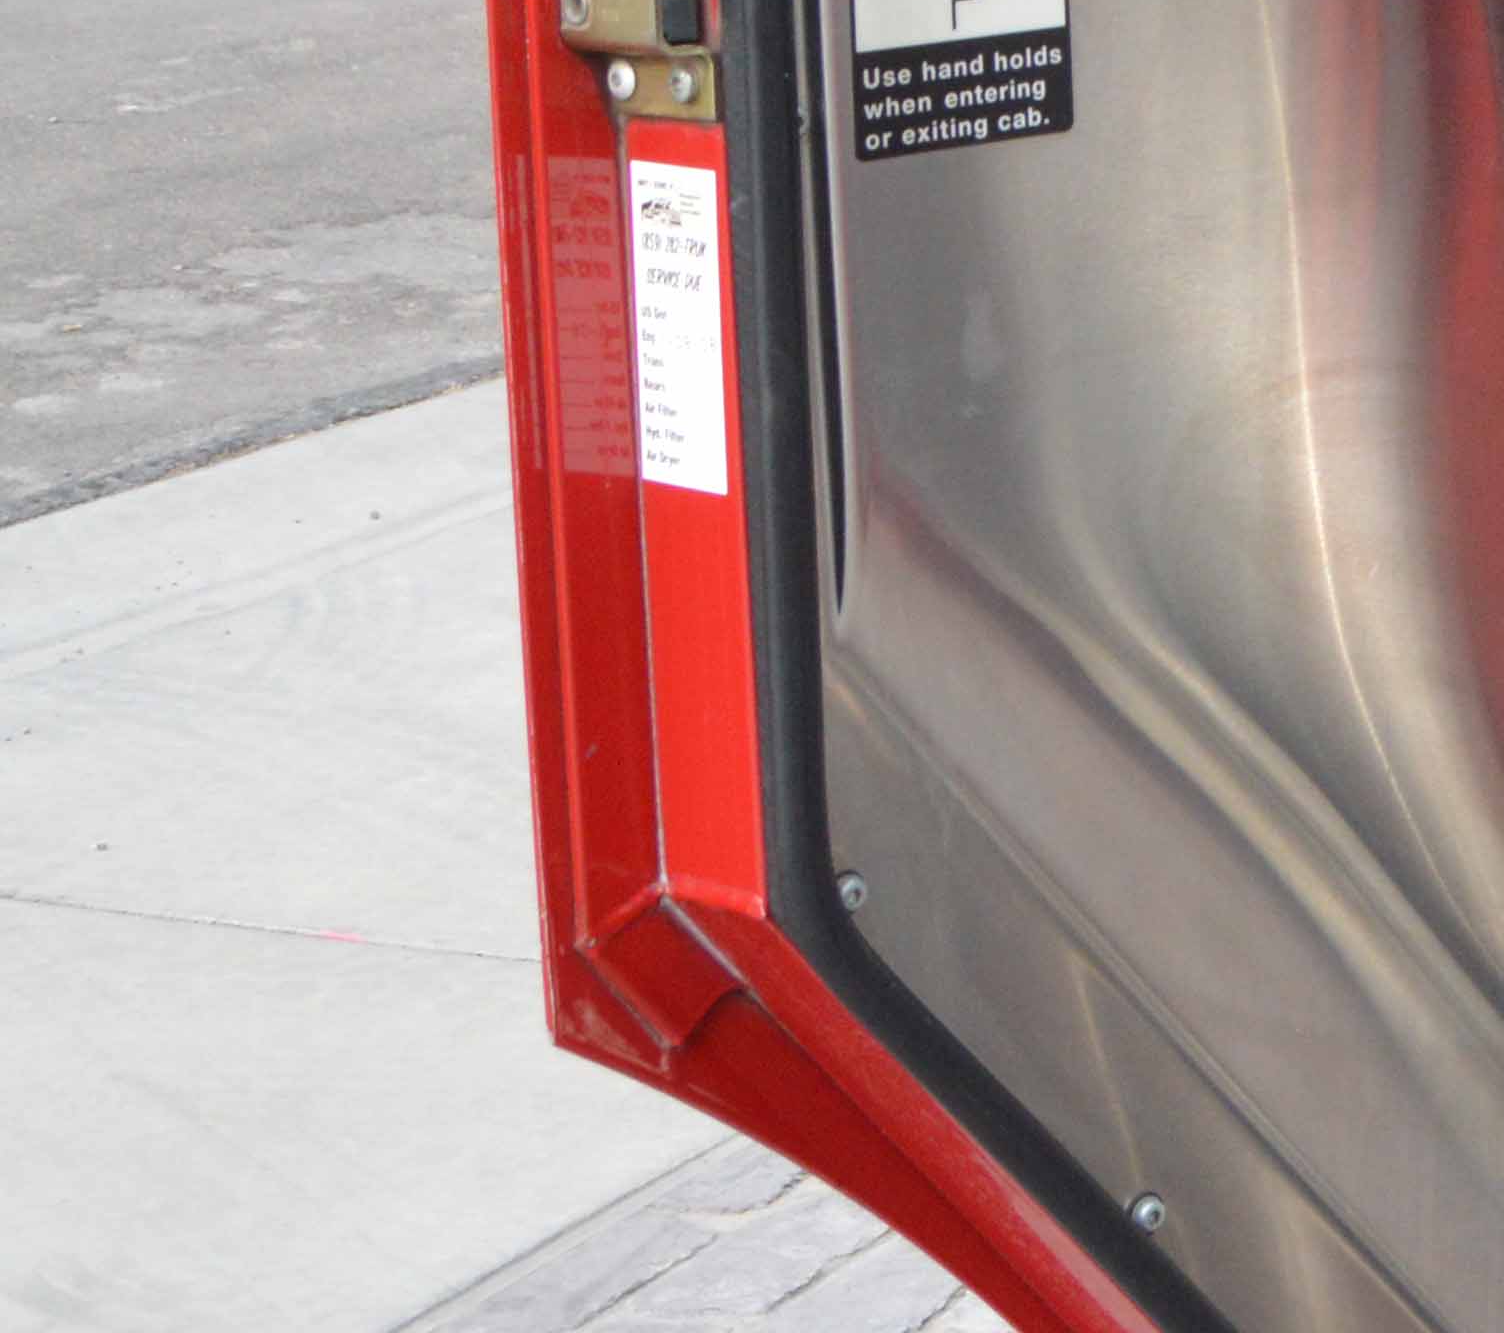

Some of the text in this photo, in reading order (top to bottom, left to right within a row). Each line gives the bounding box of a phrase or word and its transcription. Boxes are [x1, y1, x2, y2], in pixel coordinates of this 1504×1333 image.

[862, 45, 1063, 90] Use hand holds
[864, 80, 1047, 120] when entering
[865, 106, 1050, 150] or exiting cab.
